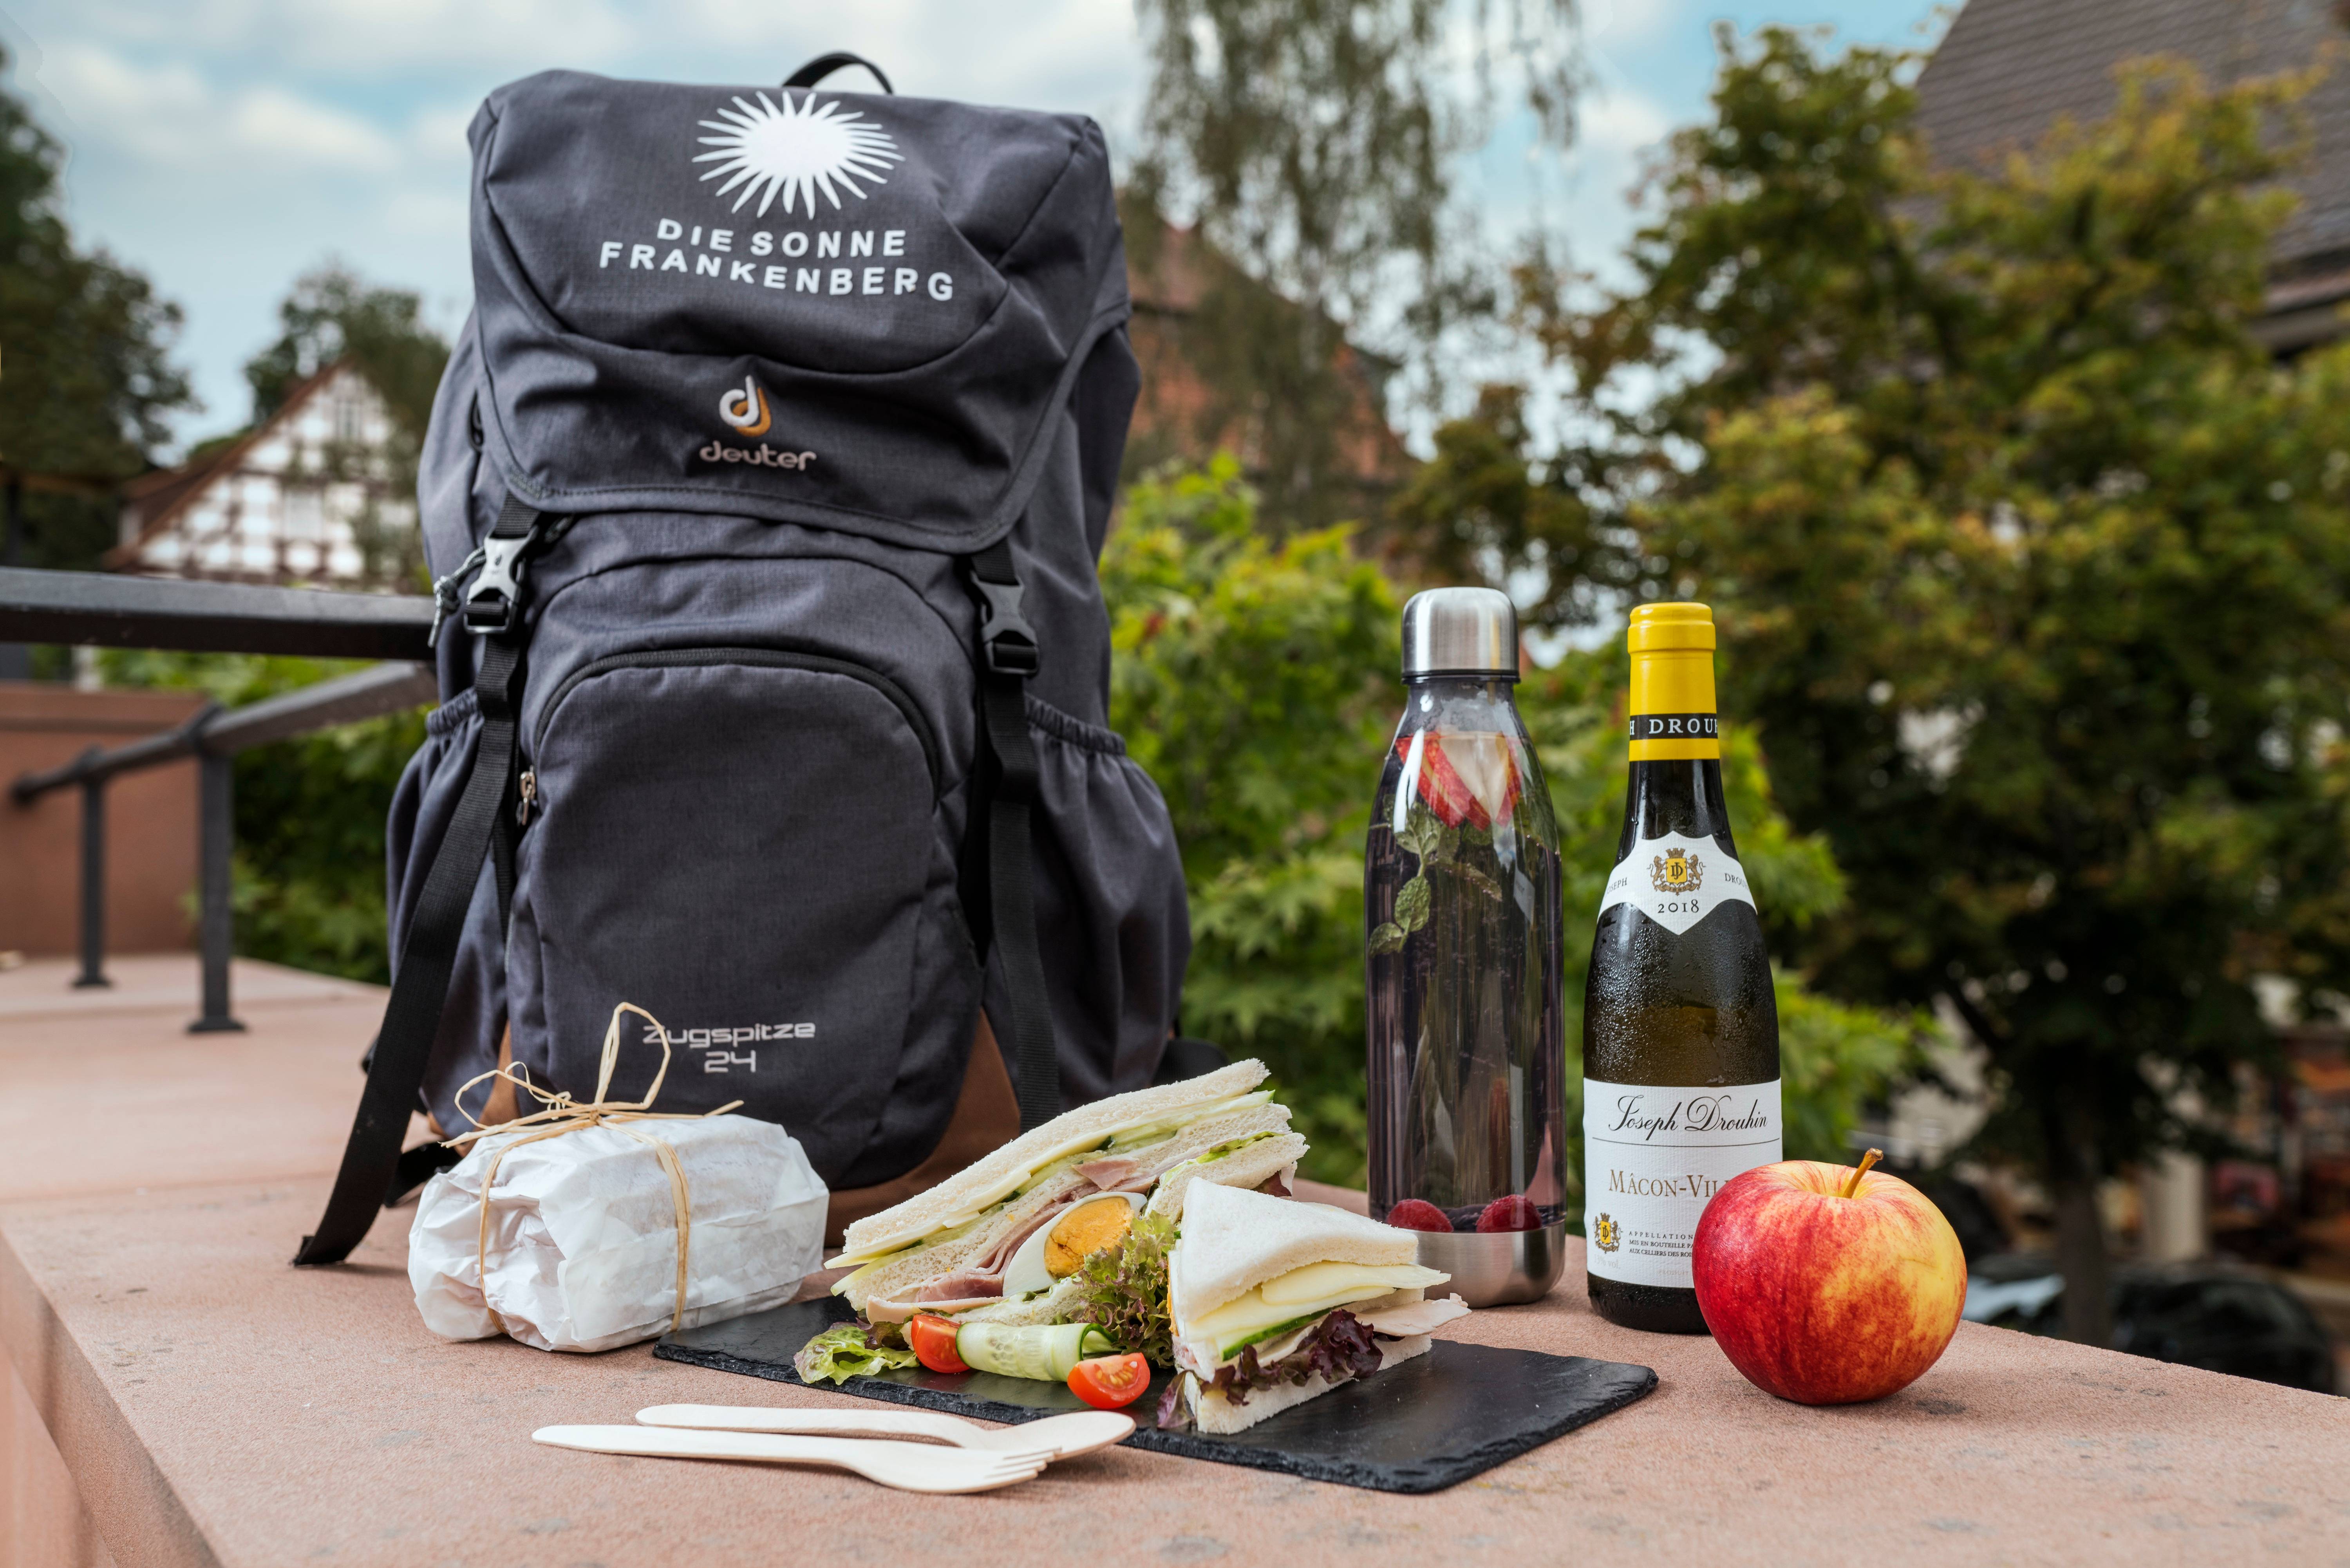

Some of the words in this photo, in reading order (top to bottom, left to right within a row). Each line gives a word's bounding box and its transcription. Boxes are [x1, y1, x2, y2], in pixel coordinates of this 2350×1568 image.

[657, 218, 734, 252] DIE
[750, 230, 906, 258] SONNE
[600, 241, 953, 301] FRANKENBERG
[699, 440, 817, 470] deuter
[1607, 877, 1627, 894] OSEPH
[1658, 899, 1699, 913] 2018
[642, 1022, 816, 1048] Zugspitze
[704, 1050, 756, 1073] 24
[1609, 1095, 1682, 1141] Joseph
[1685, 1095, 1768, 1132] Drouhin
[1629, 1231, 1693, 1240] APPELLATION
